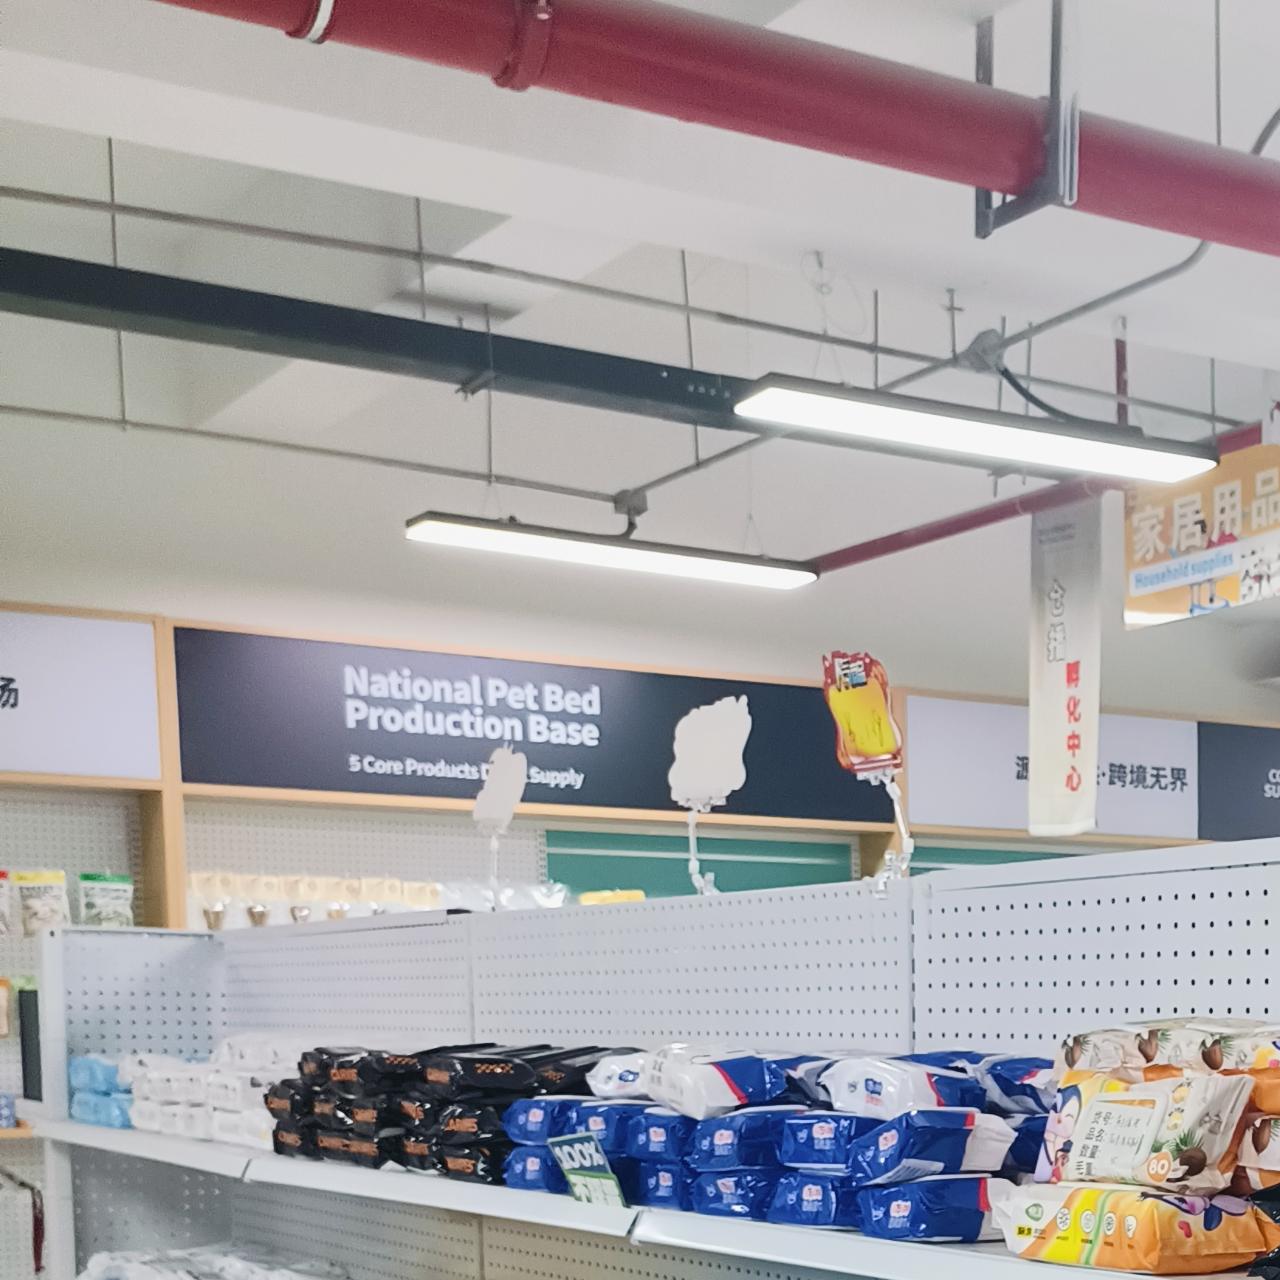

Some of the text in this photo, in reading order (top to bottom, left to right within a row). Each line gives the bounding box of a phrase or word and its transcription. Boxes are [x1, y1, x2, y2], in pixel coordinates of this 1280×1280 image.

[1135, 553, 1234, 590] Household supplies
[343, 665, 601, 715] National Pet Bed
[346, 699, 600, 746] Production Base
[349, 755, 361, 772] 5
[363, 755, 403, 776] Core
[405, 757, 480, 780] Products
[529, 766, 585, 790] Supply
[554, 1141, 605, 1169] 100%
[1148, 1159, 1169, 1174] 80
